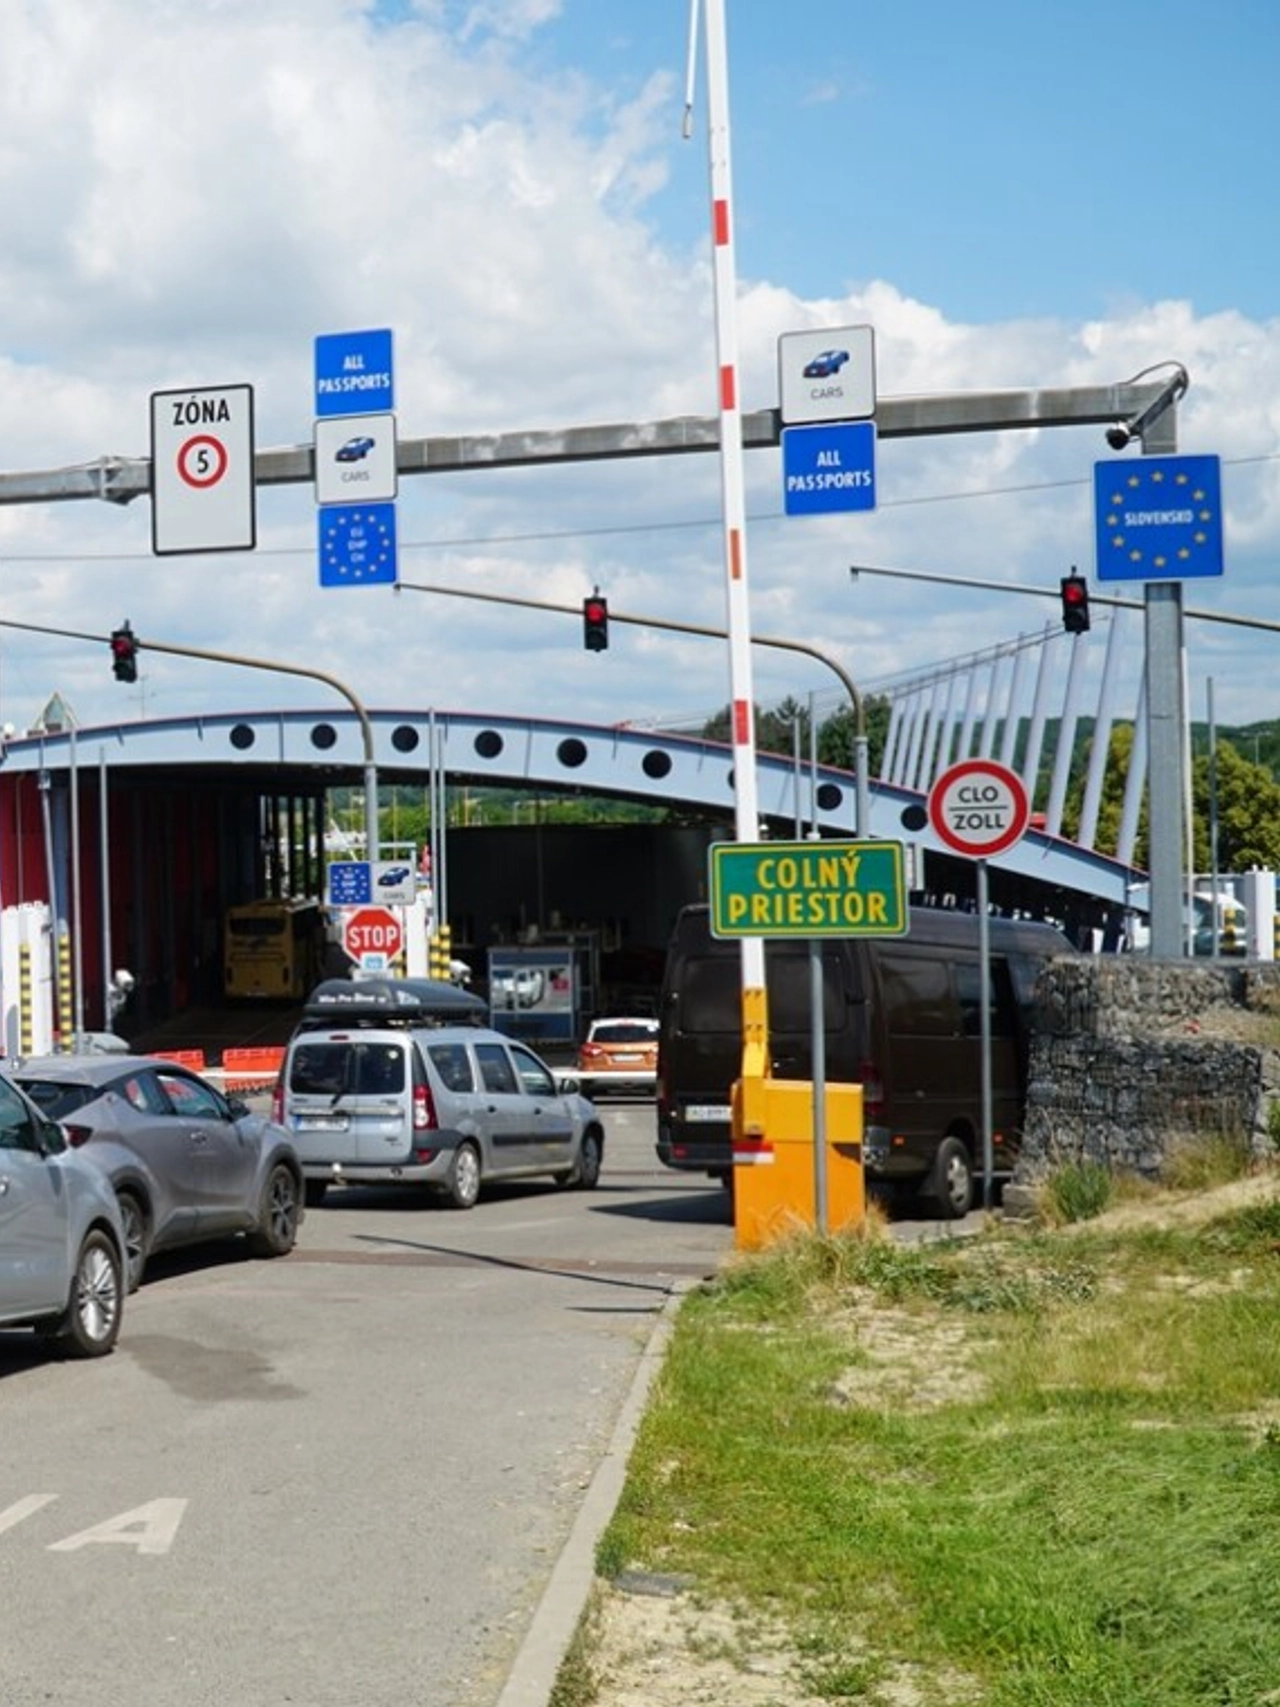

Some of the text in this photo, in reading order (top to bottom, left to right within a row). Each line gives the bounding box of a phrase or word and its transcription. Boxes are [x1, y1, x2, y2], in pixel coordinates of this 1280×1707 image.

[343, 354, 364, 370] ALL
[318, 372, 390, 393] PASSPORTS
[810, 386, 843, 399] CARS
[173, 395, 230, 426] ZÓNA
[197, 449, 209, 473] 5
[817, 450, 841, 467] ALL
[341, 471, 370, 482] CARS
[788, 470, 871, 492] PASSPORTS
[1124, 509, 1194, 527] SLOVENSKO
[958, 785, 999, 803] CLO
[953, 813, 1005, 830] ZOLL
[757, 848, 861, 888] COLNÝ
[728, 892, 888, 924] PRIESTOR
[349, 925, 398, 949] STOP
